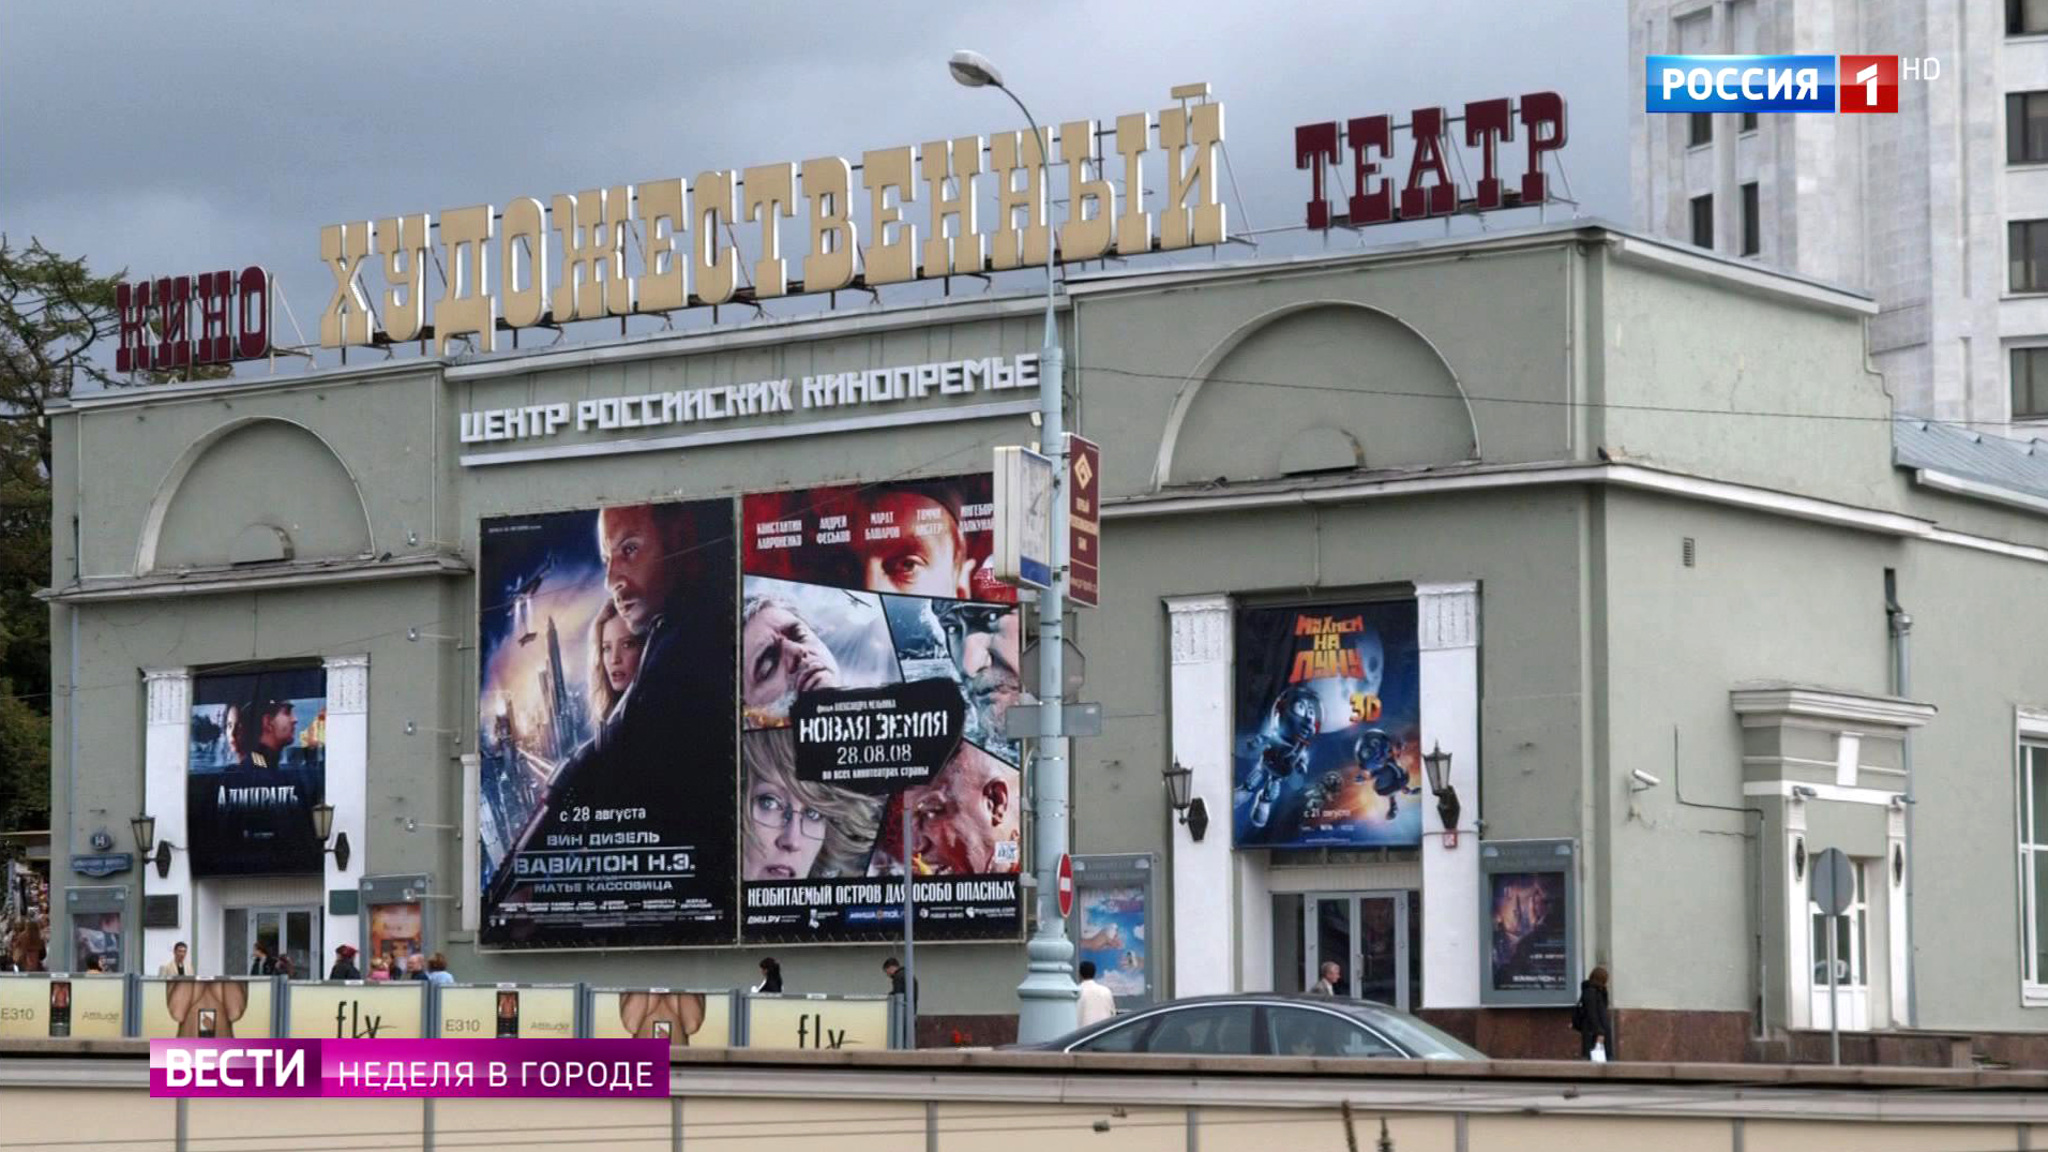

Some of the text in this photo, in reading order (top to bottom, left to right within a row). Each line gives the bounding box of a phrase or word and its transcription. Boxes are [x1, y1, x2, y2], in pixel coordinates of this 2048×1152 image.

[1294, 90, 1568, 230] ТЕАТР
[319, 82, 1228, 354] ХУДОЖЕСТВЕННЫЙ
[115, 265, 270, 373] КИНО
[460, 402, 570, 443] ЦЕНТР
[801, 353, 1041, 409] КИНОПРЕМЬЕ
[1314, 633, 1340, 650] НА
[1349, 692, 1382, 722] 3D
[799, 710, 948, 743] НОВАЯ ЗЕМЛЯ
[836, 743, 912, 765] 28.08.08
[560, 806, 647, 823] с 28 августа
[546, 831, 661, 847] ВИН ДИЗЕЛЬ
[513, 852, 696, 874] ВАВИЛОН Н.Э.
[533, 880, 673, 893] МАТЬЕ КАССОВИЦА
[747, 885, 832, 907] НЕОБИТАЕМЫЙ
[835, 884, 882, 905] ОСТРОВ
[913, 882, 952, 902] ОСОБО
[956, 880, 1016, 901] ОПАСНЫХ
[1, 1007, 34, 1021] E310
[336, 1000, 388, 1039] fly
[445, 1019, 481, 1032] E310
[797, 1014, 853, 1049] fly
